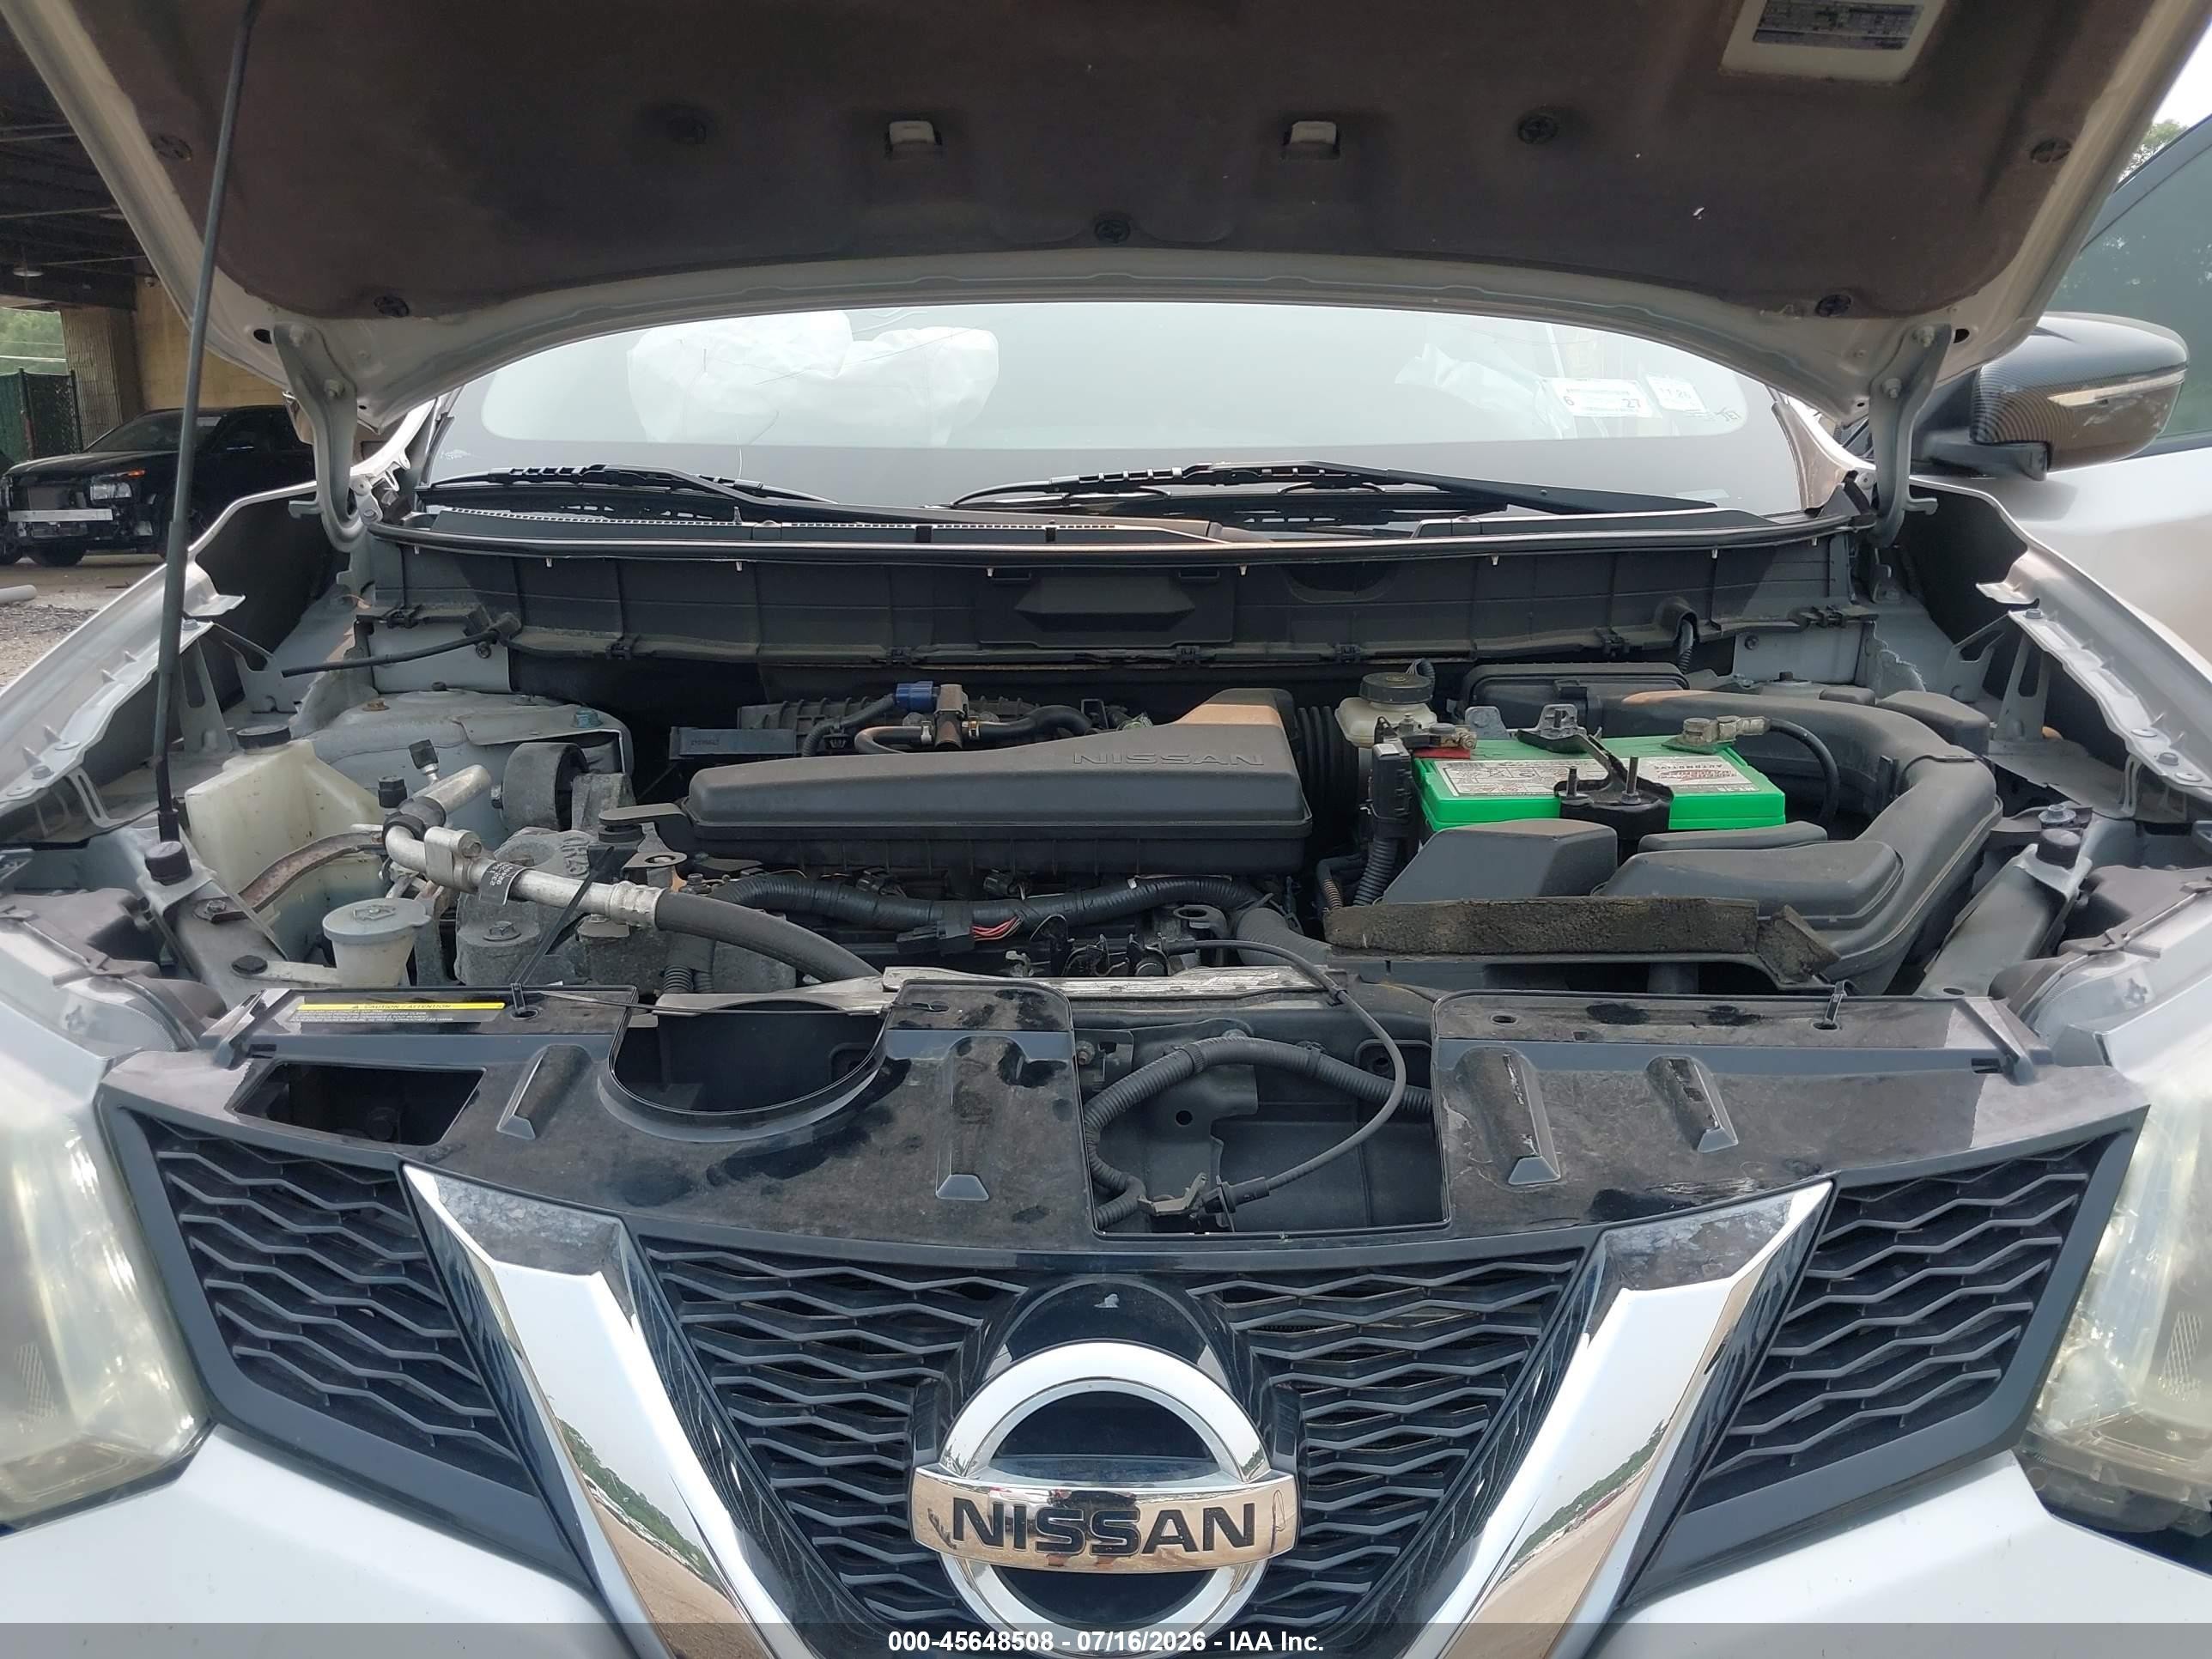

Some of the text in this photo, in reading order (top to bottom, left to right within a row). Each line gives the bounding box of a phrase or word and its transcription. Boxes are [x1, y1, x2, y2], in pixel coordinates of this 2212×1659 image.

[1564, 395, 1642, 408] 6 27
[1073, 753, 1265, 766] NISSAN
[952, 1497, 1256, 1557] NISSAN
